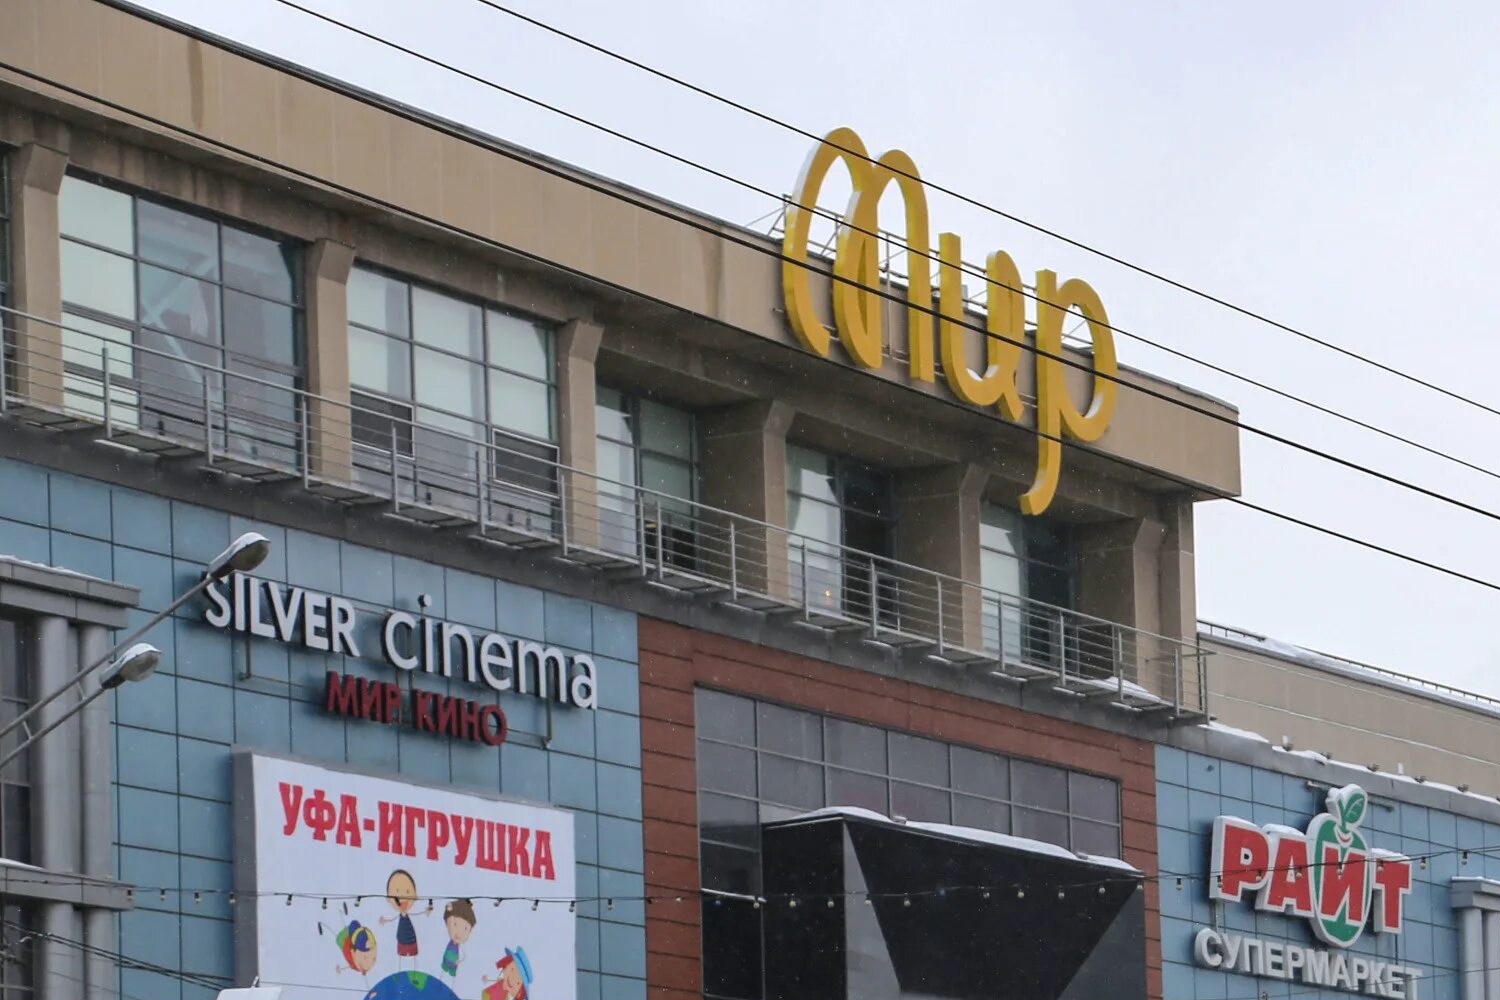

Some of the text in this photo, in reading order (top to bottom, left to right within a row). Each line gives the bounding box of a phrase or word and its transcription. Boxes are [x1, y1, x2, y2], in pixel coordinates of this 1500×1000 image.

[204, 570, 598, 710] SILVER cinema
[326, 671, 508, 746] МИР КИНО
[278, 782, 555, 880] УФА-ИГРУШКА
[1209, 815, 1412, 946] РАЙТ
[1195, 927, 1423, 1000] СУПЕРМАРКЕТ
